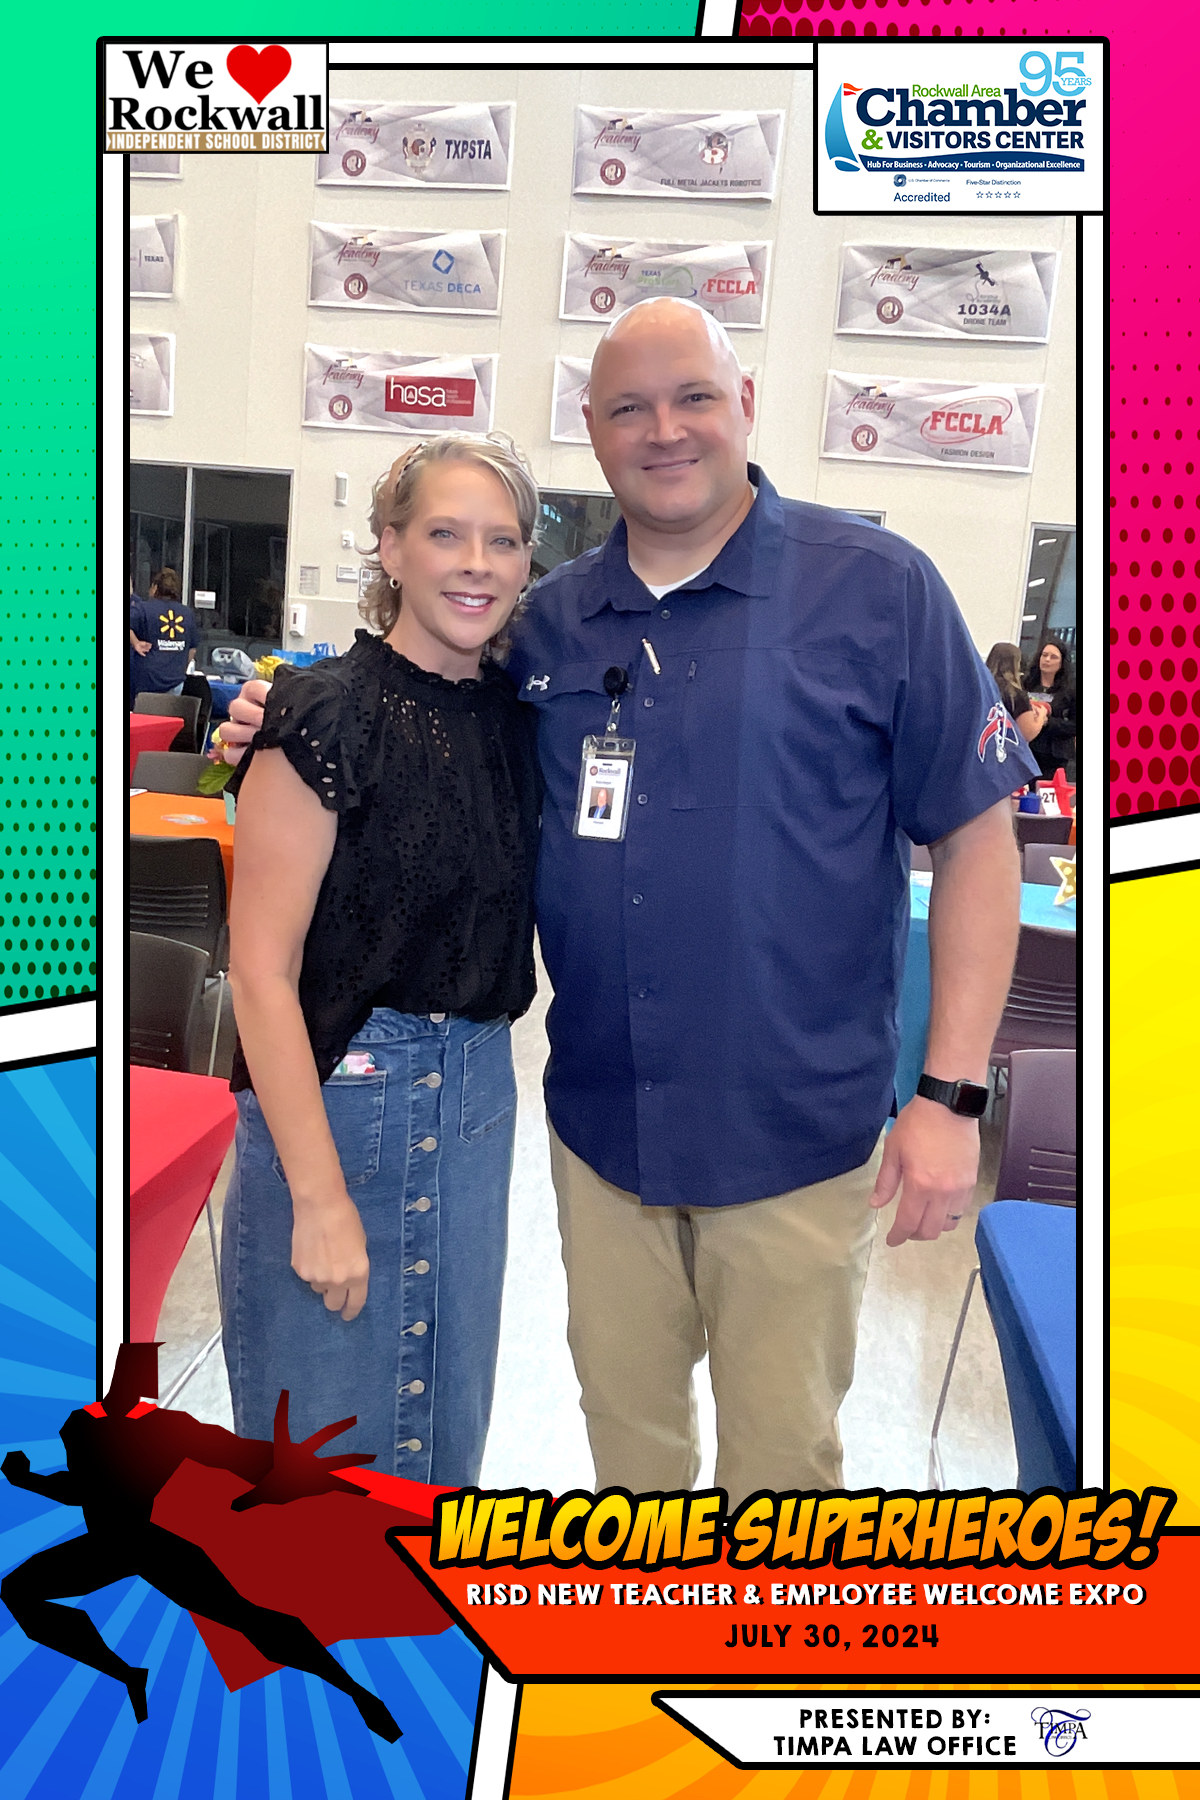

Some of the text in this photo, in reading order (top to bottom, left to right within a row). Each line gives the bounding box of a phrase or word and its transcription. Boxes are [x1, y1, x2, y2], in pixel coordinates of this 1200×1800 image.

[445, 139, 492, 160] TXPSTA
[404, 280, 481, 294] TEXAS DECA
[706, 278, 756, 295] FCCLA
[958, 303, 1011, 316] 1034A
[390, 377, 447, 408] hosa
[929, 410, 1003, 435] FCCLA
